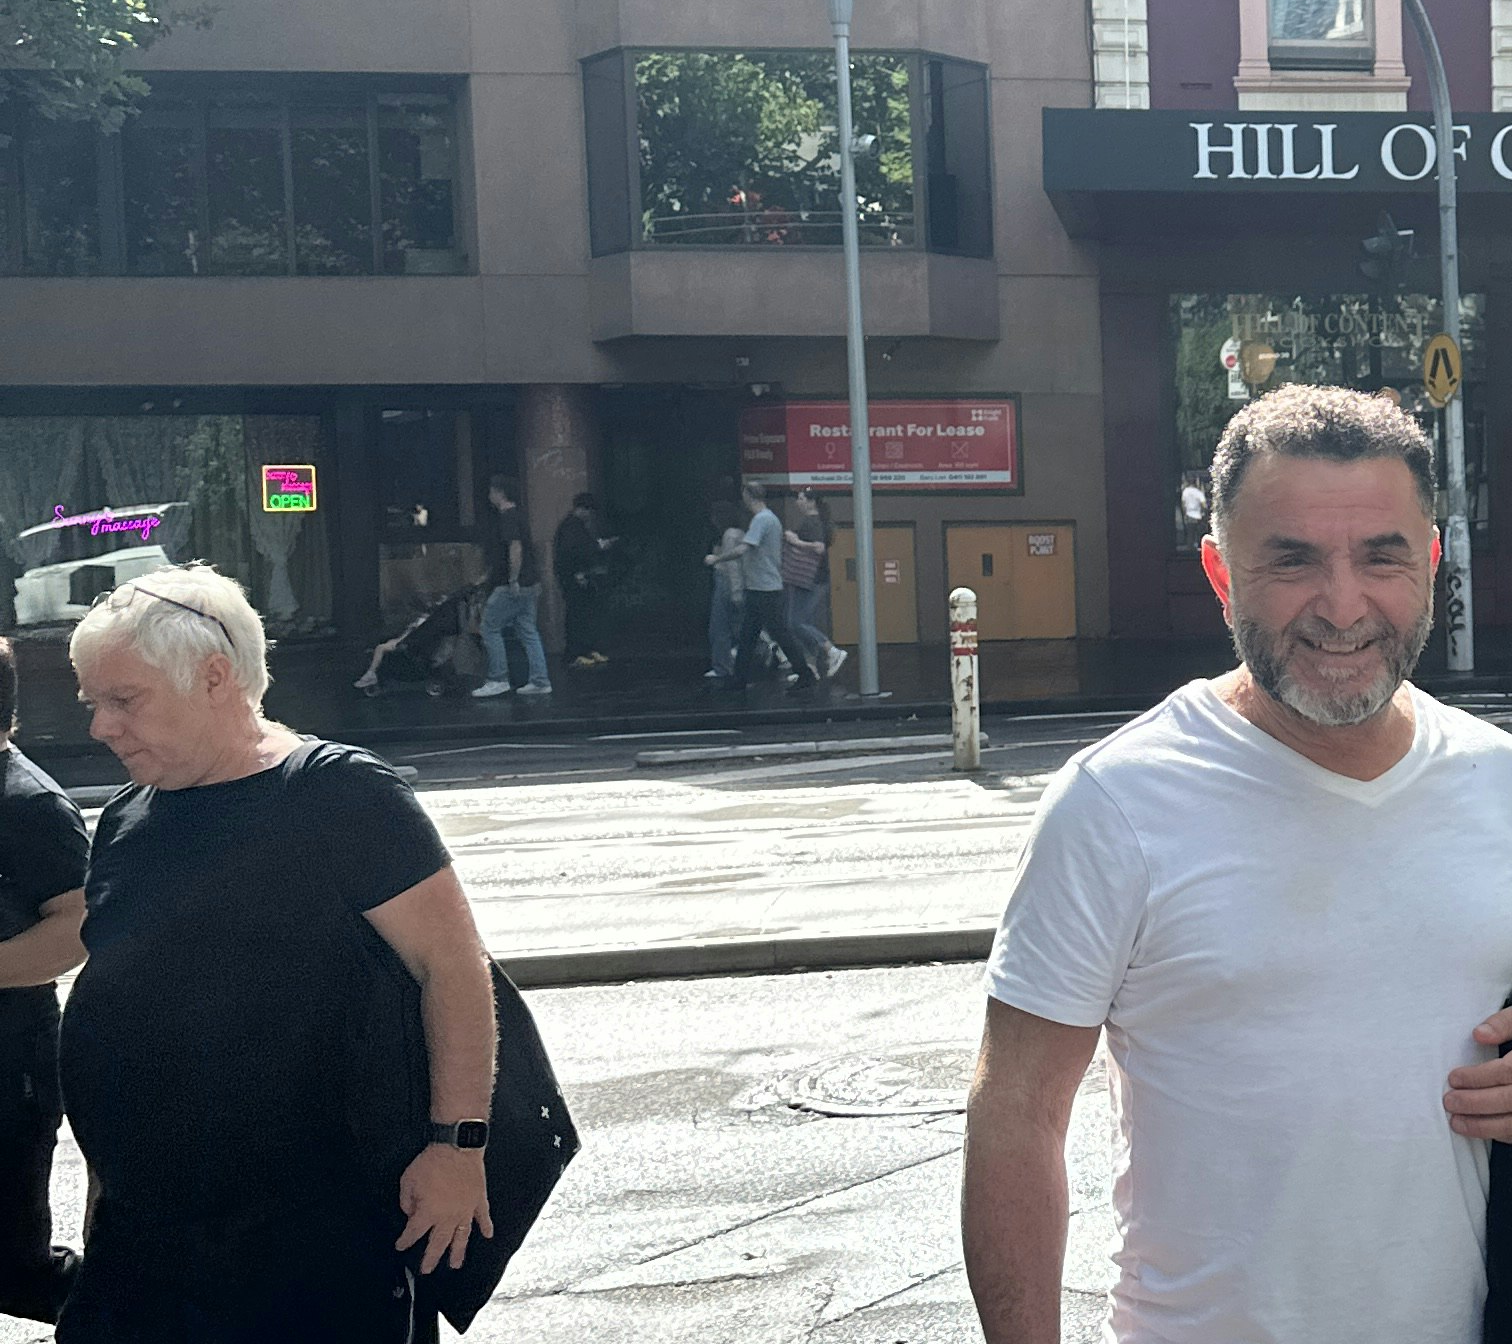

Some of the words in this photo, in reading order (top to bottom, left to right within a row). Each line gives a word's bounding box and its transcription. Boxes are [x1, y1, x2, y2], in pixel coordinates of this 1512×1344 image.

[1189, 122, 1359, 179] HILL
[1381, 124, 1471, 180] OF
[1324, 312, 1429, 340] CONTENT
[810, 423, 904, 438] Restrant
[907, 423, 934, 437] For
[937, 423, 985, 437] Lease
[270, 494, 310, 509] OPEN
[101, 516, 160, 541] massage
